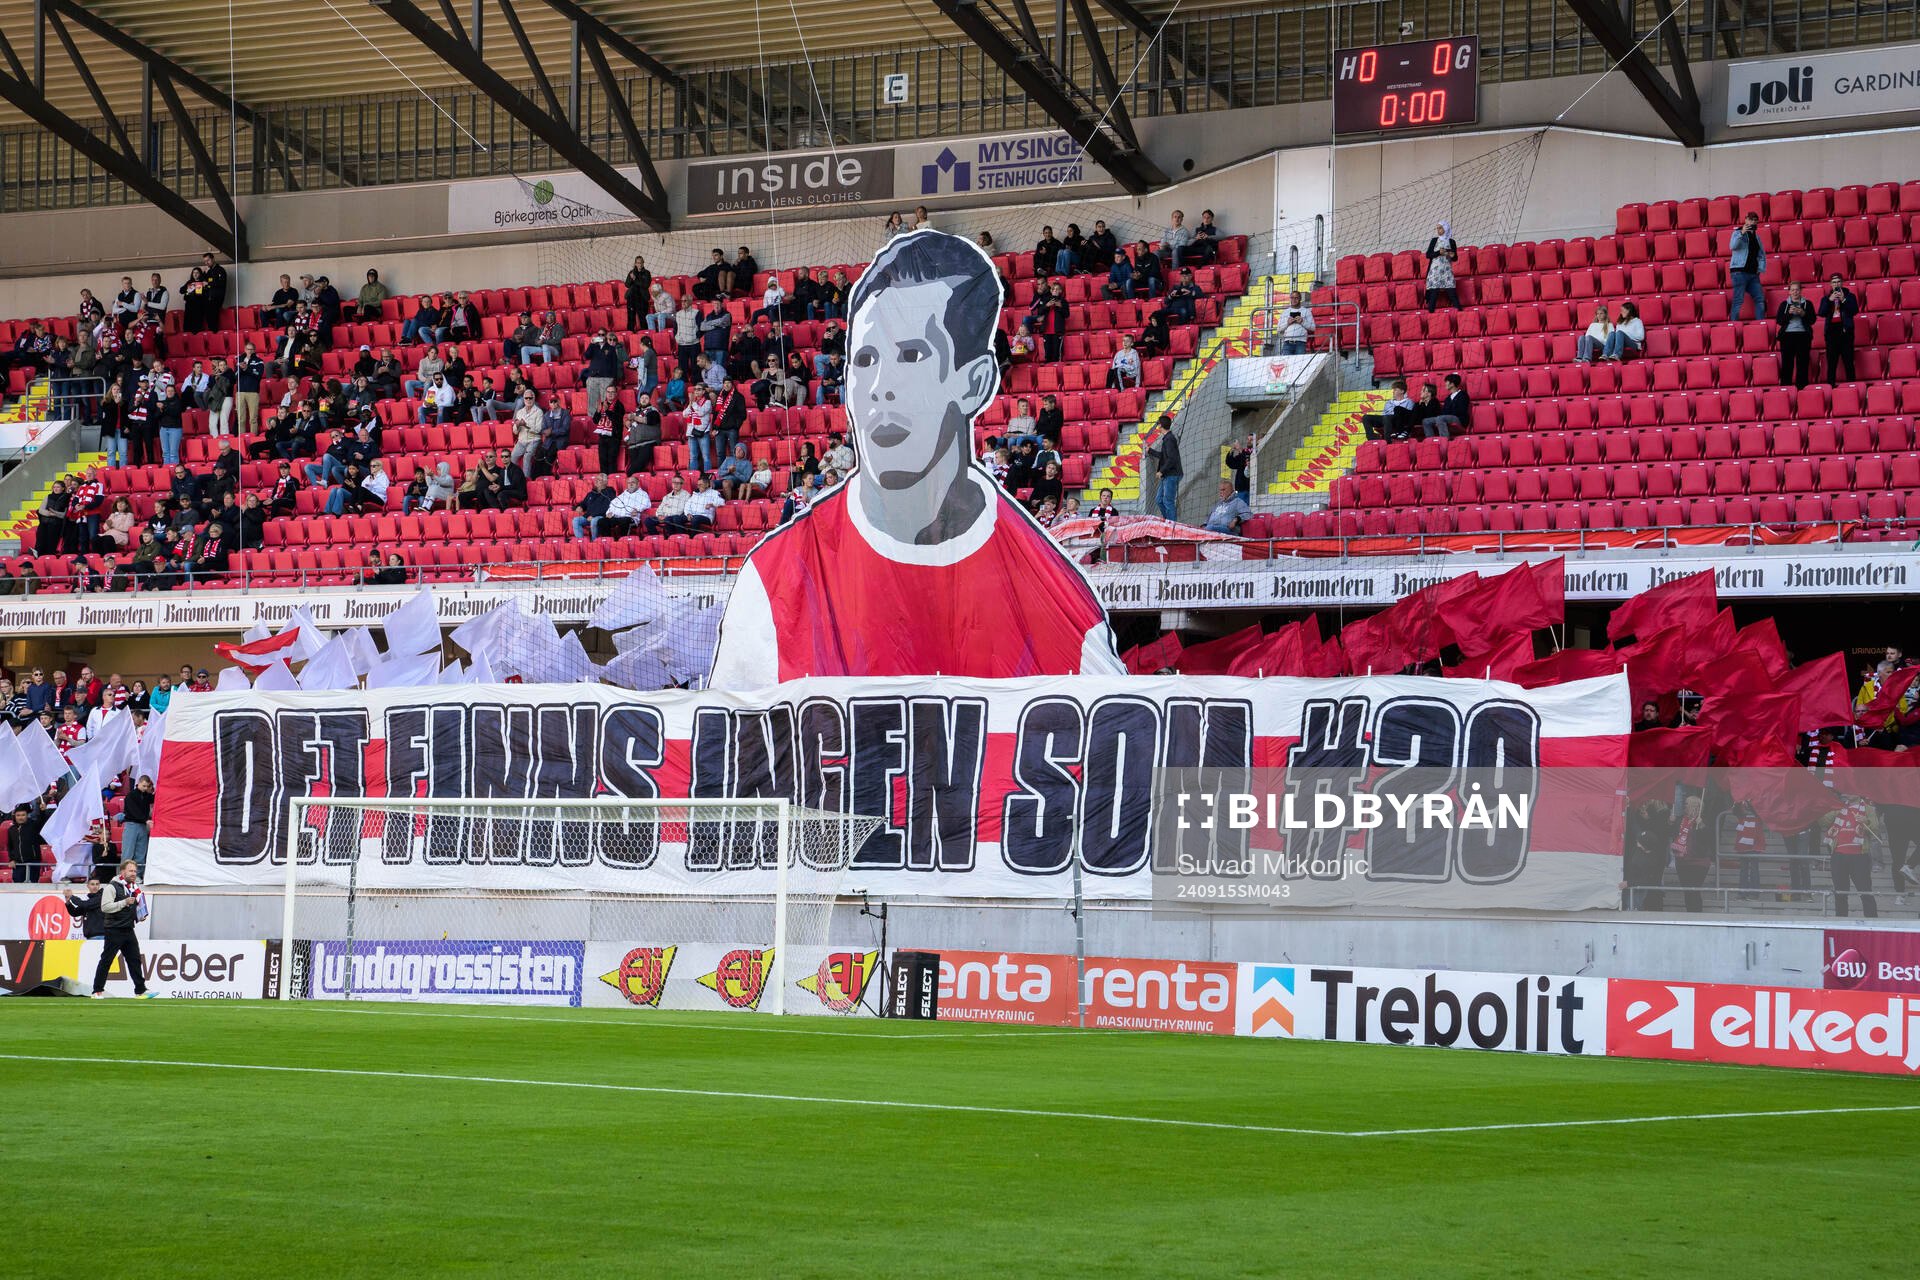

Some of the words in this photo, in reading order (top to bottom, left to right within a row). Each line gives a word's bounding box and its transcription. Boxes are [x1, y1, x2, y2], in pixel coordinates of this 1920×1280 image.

[888, 75, 904, 102] E
[1380, 90, 1446, 126] 0:00
[717, 157, 863, 196] inside
[978, 165, 1083, 190] STENHUGGERI
[494, 209, 558, 227] Björkegrens
[561, 204, 593, 221] Optik
[717, 199, 765, 211] QUALITY
[771, 196, 803, 207] MENS
[808, 191, 862, 204] CLOTHES
[78, 606, 153, 625] Barometern
[164, 603, 240, 623] Barometern
[1155, 579, 1254, 601] Barometern
[1271, 576, 1374, 598] Barometern
[1783, 562, 1907, 588] Barometern
[213, 707, 371, 866] DET
[382, 702, 663, 870] FINNS
[685, 696, 988, 873] INGEN
[1001, 695, 1253, 875] SOM
[35, 913, 63, 935] NS
[268, 952, 280, 998] SELECT
[291, 953, 303, 999] SELECT
[938, 953, 1052, 1003] enta
[1083, 962, 1229, 1012] renta
[1837, 961, 1867, 978] BW
[171, 990, 243, 999] SAINT-GOBAIN
[896, 966, 908, 1016] SELECT
[921, 967, 933, 1018] SELECT
[1096, 1015, 1214, 1032] MASKINUTHYRNING
[1310, 968, 1584, 1054] Trebolit
